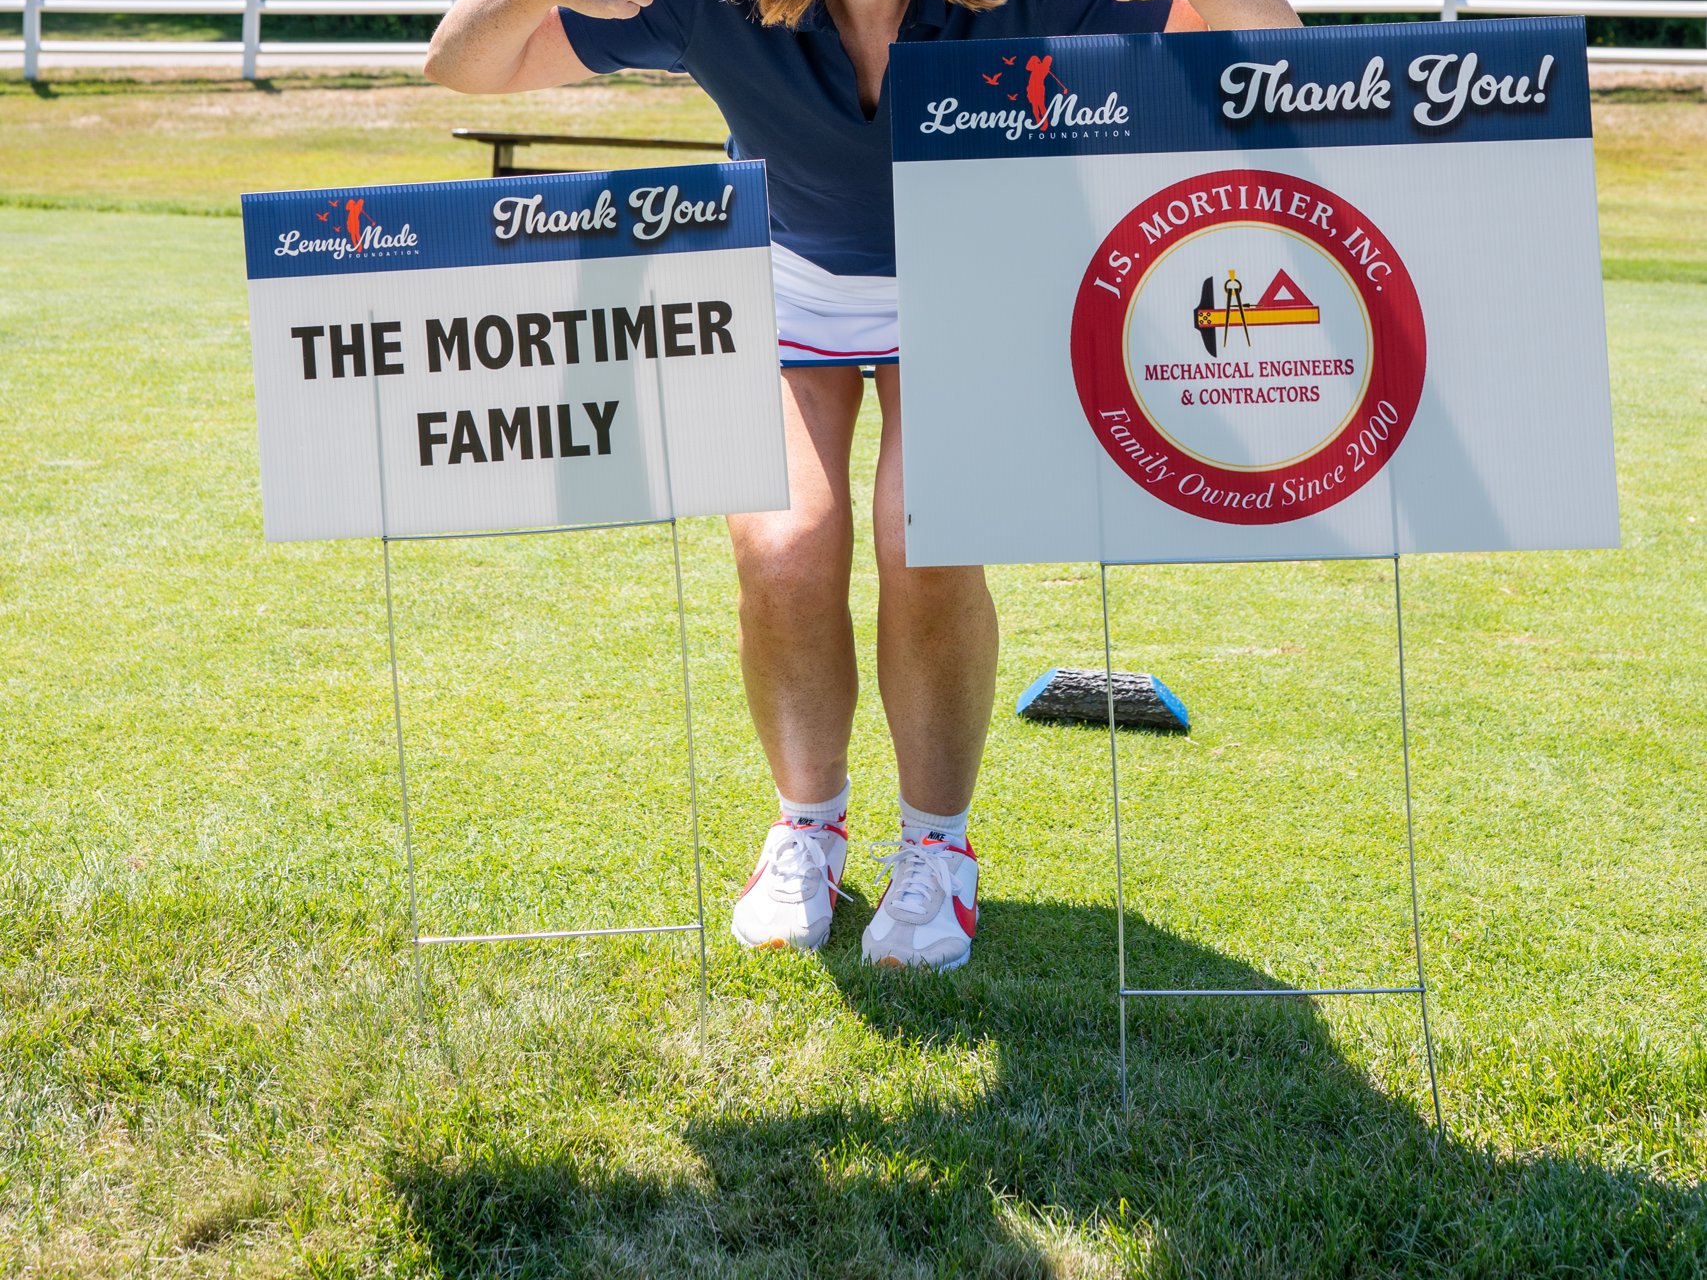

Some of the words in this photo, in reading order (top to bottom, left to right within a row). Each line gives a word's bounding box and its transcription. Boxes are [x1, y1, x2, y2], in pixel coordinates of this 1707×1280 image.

[1220, 55, 1391, 119] Thank
[1408, 52, 1555, 127] You!
[1028, 129, 1131, 140] FOUNDATION
[493, 189, 617, 240] Thank
[628, 184, 734, 241] You!
[348, 249, 420, 259] FOUNDATION
[1093, 249, 1141, 299] J.S.
[1138, 185, 1338, 245] MORTIMER,
[1341, 226, 1393, 292] INC.
[291, 321, 404, 380] THE
[425, 300, 736, 373] MORTIMER
[1144, 362, 1255, 381] MECHANICAL
[1258, 358, 1355, 378] ENGINEERS
[1180, 388, 1195, 406] &
[1199, 385, 1320, 405] CONTRACTORS
[417, 401, 620, 466] FAMILY
[1099, 407, 1176, 484] Family
[1177, 472, 1276, 509] Owned
[1281, 463, 1347, 507] Since
[1345, 400, 1399, 472] 2000
[927, 830, 946, 842] NIKE
